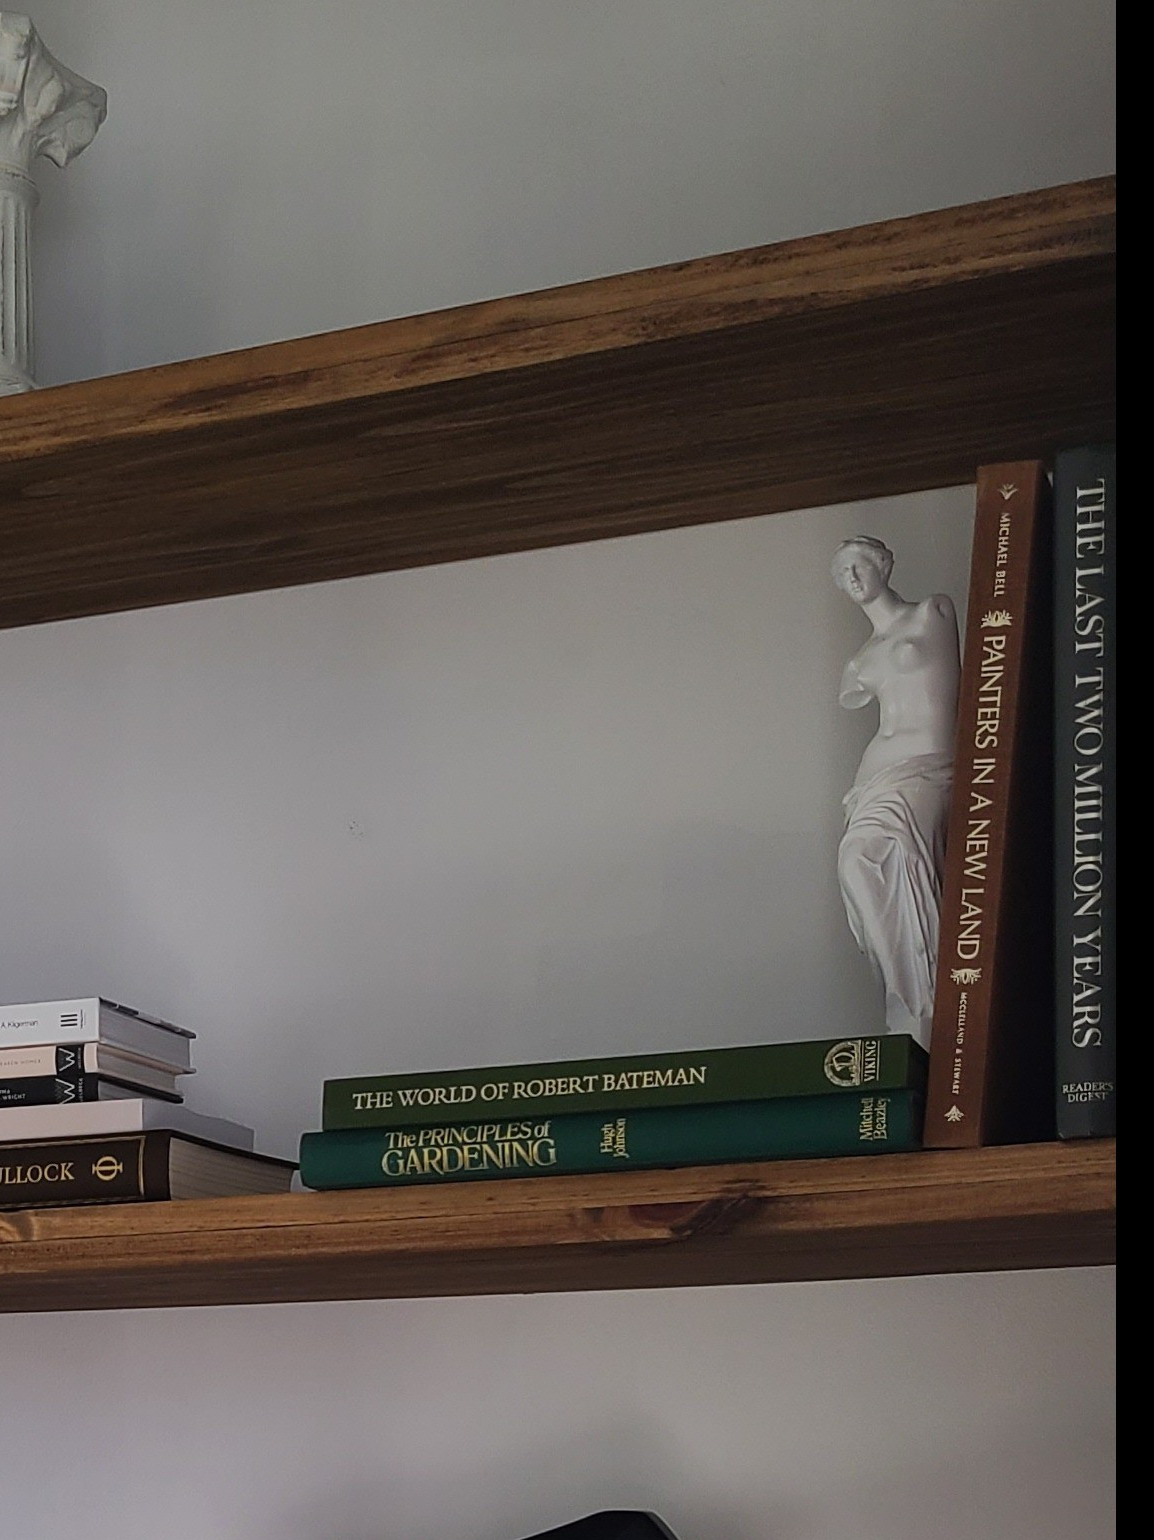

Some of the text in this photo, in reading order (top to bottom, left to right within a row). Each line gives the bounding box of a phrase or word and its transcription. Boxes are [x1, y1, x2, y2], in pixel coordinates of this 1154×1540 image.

[994, 511, 1011, 598] MICHAEL BELL
[1072, 478, 1105, 1048] THE LAST TWO MILLION YEARS
[956, 634, 1006, 960] PAINTERS IN A NEW LAND
[864, 1040, 877, 1082] VIKING
[951, 1058, 962, 1095] STEWART
[352, 1066, 708, 1110] THE WORLD OF ROBERT BATEMAN
[1062, 1082, 1114, 1094] READER'S
[1067, 1091, 1109, 1103] DIGEST
[384, 1120, 552, 1149] The PRINCIPLES of
[600, 1122, 615, 1154] Hugh
[613, 1117, 631, 1159] Johnson
[859, 1097, 874, 1141] Mitchell
[873, 1097, 891, 1141] Beazley
[381, 1137, 558, 1176] GARDENING
